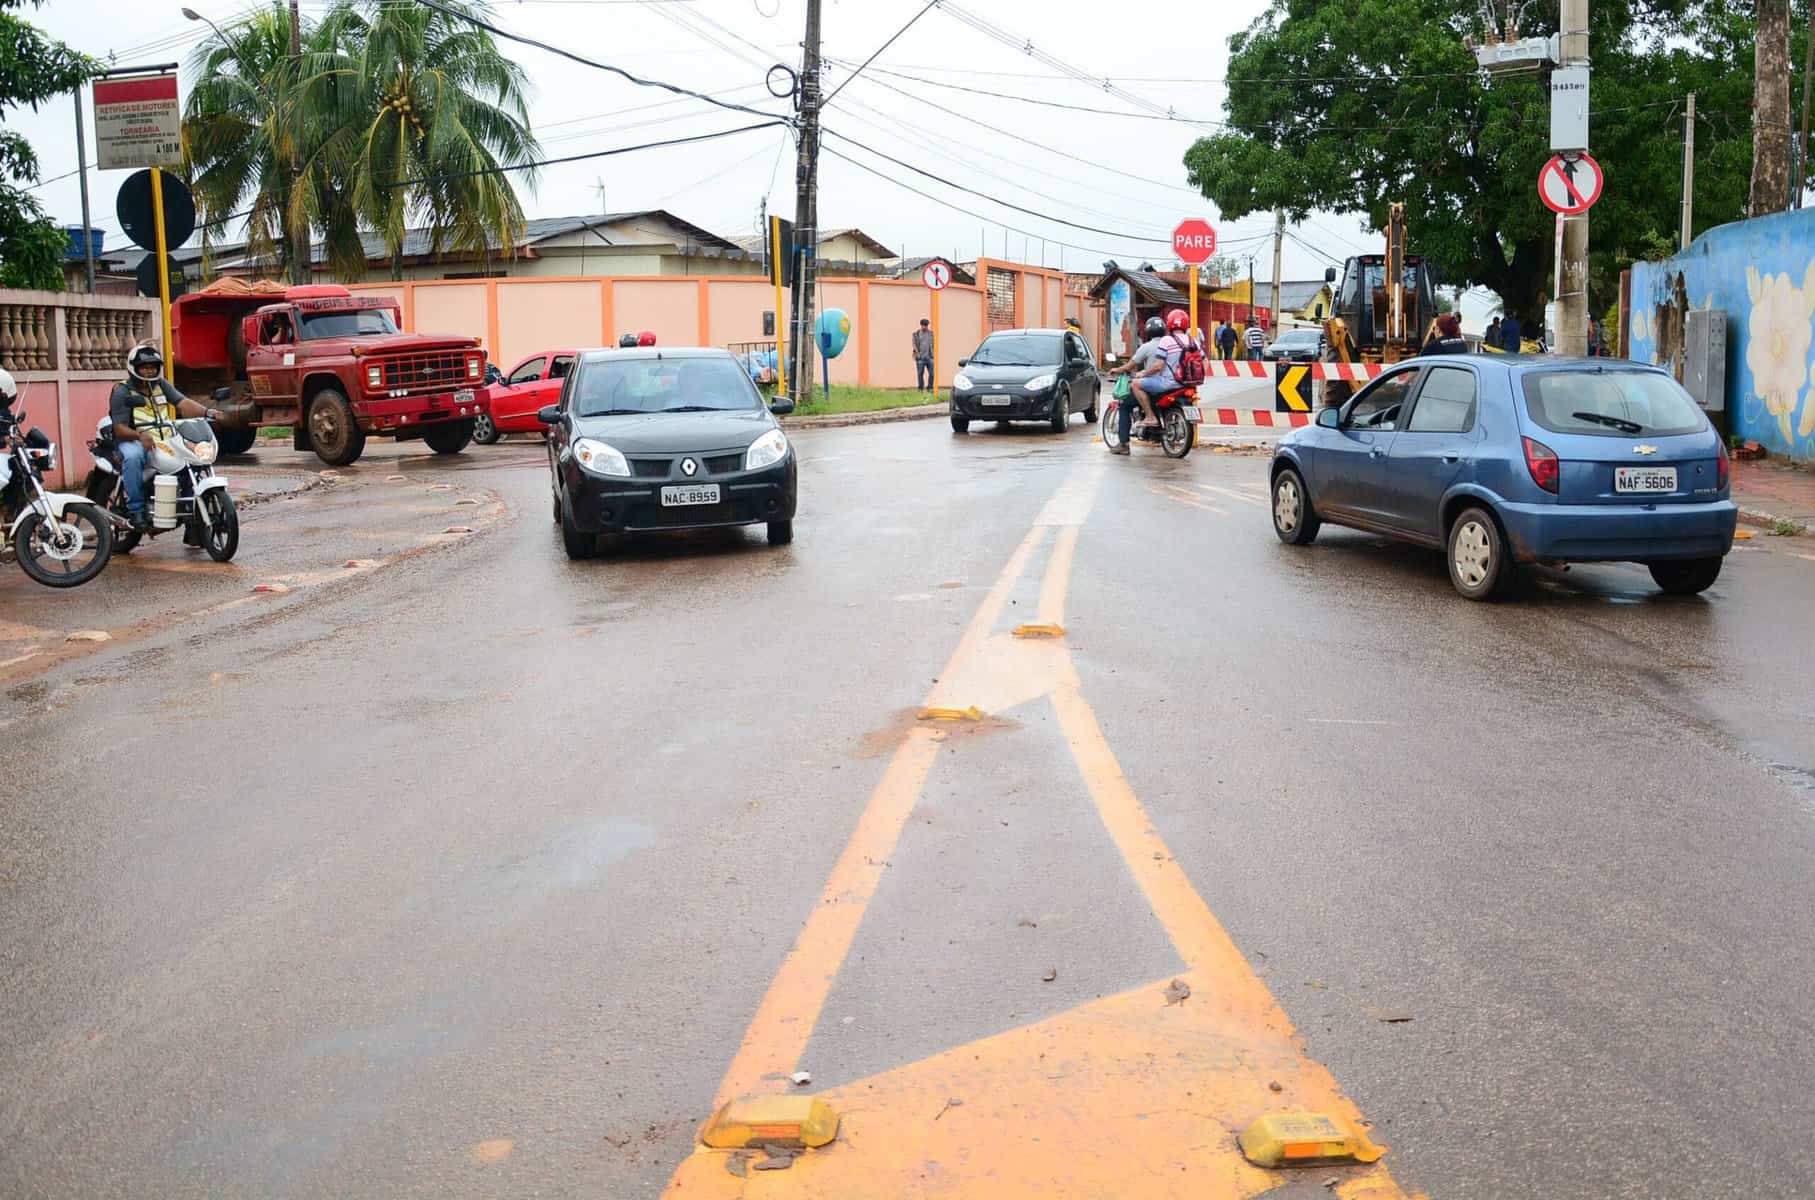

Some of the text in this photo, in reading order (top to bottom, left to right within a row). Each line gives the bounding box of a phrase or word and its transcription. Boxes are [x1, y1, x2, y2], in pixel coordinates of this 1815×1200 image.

[142, 101, 177, 111] MOTORES
[120, 126, 161, 135] TORNEARIA
[1176, 235, 1213, 248] PARE
